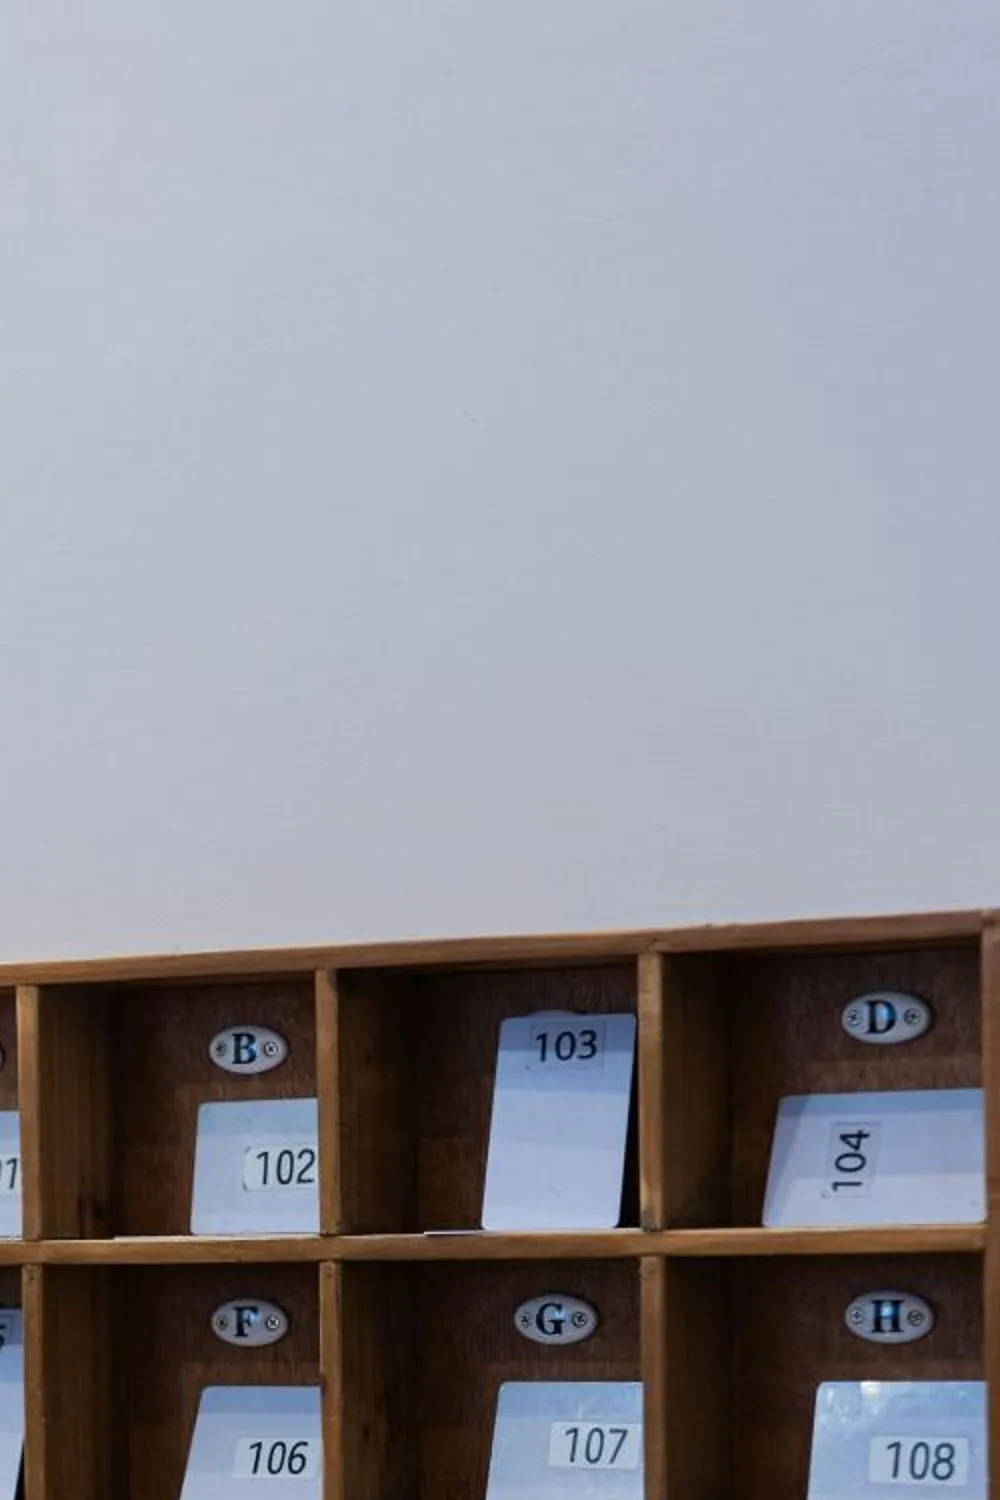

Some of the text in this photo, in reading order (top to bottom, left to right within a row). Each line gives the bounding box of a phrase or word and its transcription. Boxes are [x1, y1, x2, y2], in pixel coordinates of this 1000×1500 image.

[864, 999, 897, 1035] D
[231, 1033, 257, 1065] B
[534, 1029, 599, 1064] 103
[255, 1148, 316, 1186] 102
[831, 1128, 871, 1193] 104
[233, 1305, 258, 1338] F
[534, 1302, 566, 1336] G
[871, 1299, 904, 1334] H
[248, 1440, 308, 1475] 106
[563, 1427, 629, 1465] 107
[885, 1441, 956, 1481] 108
